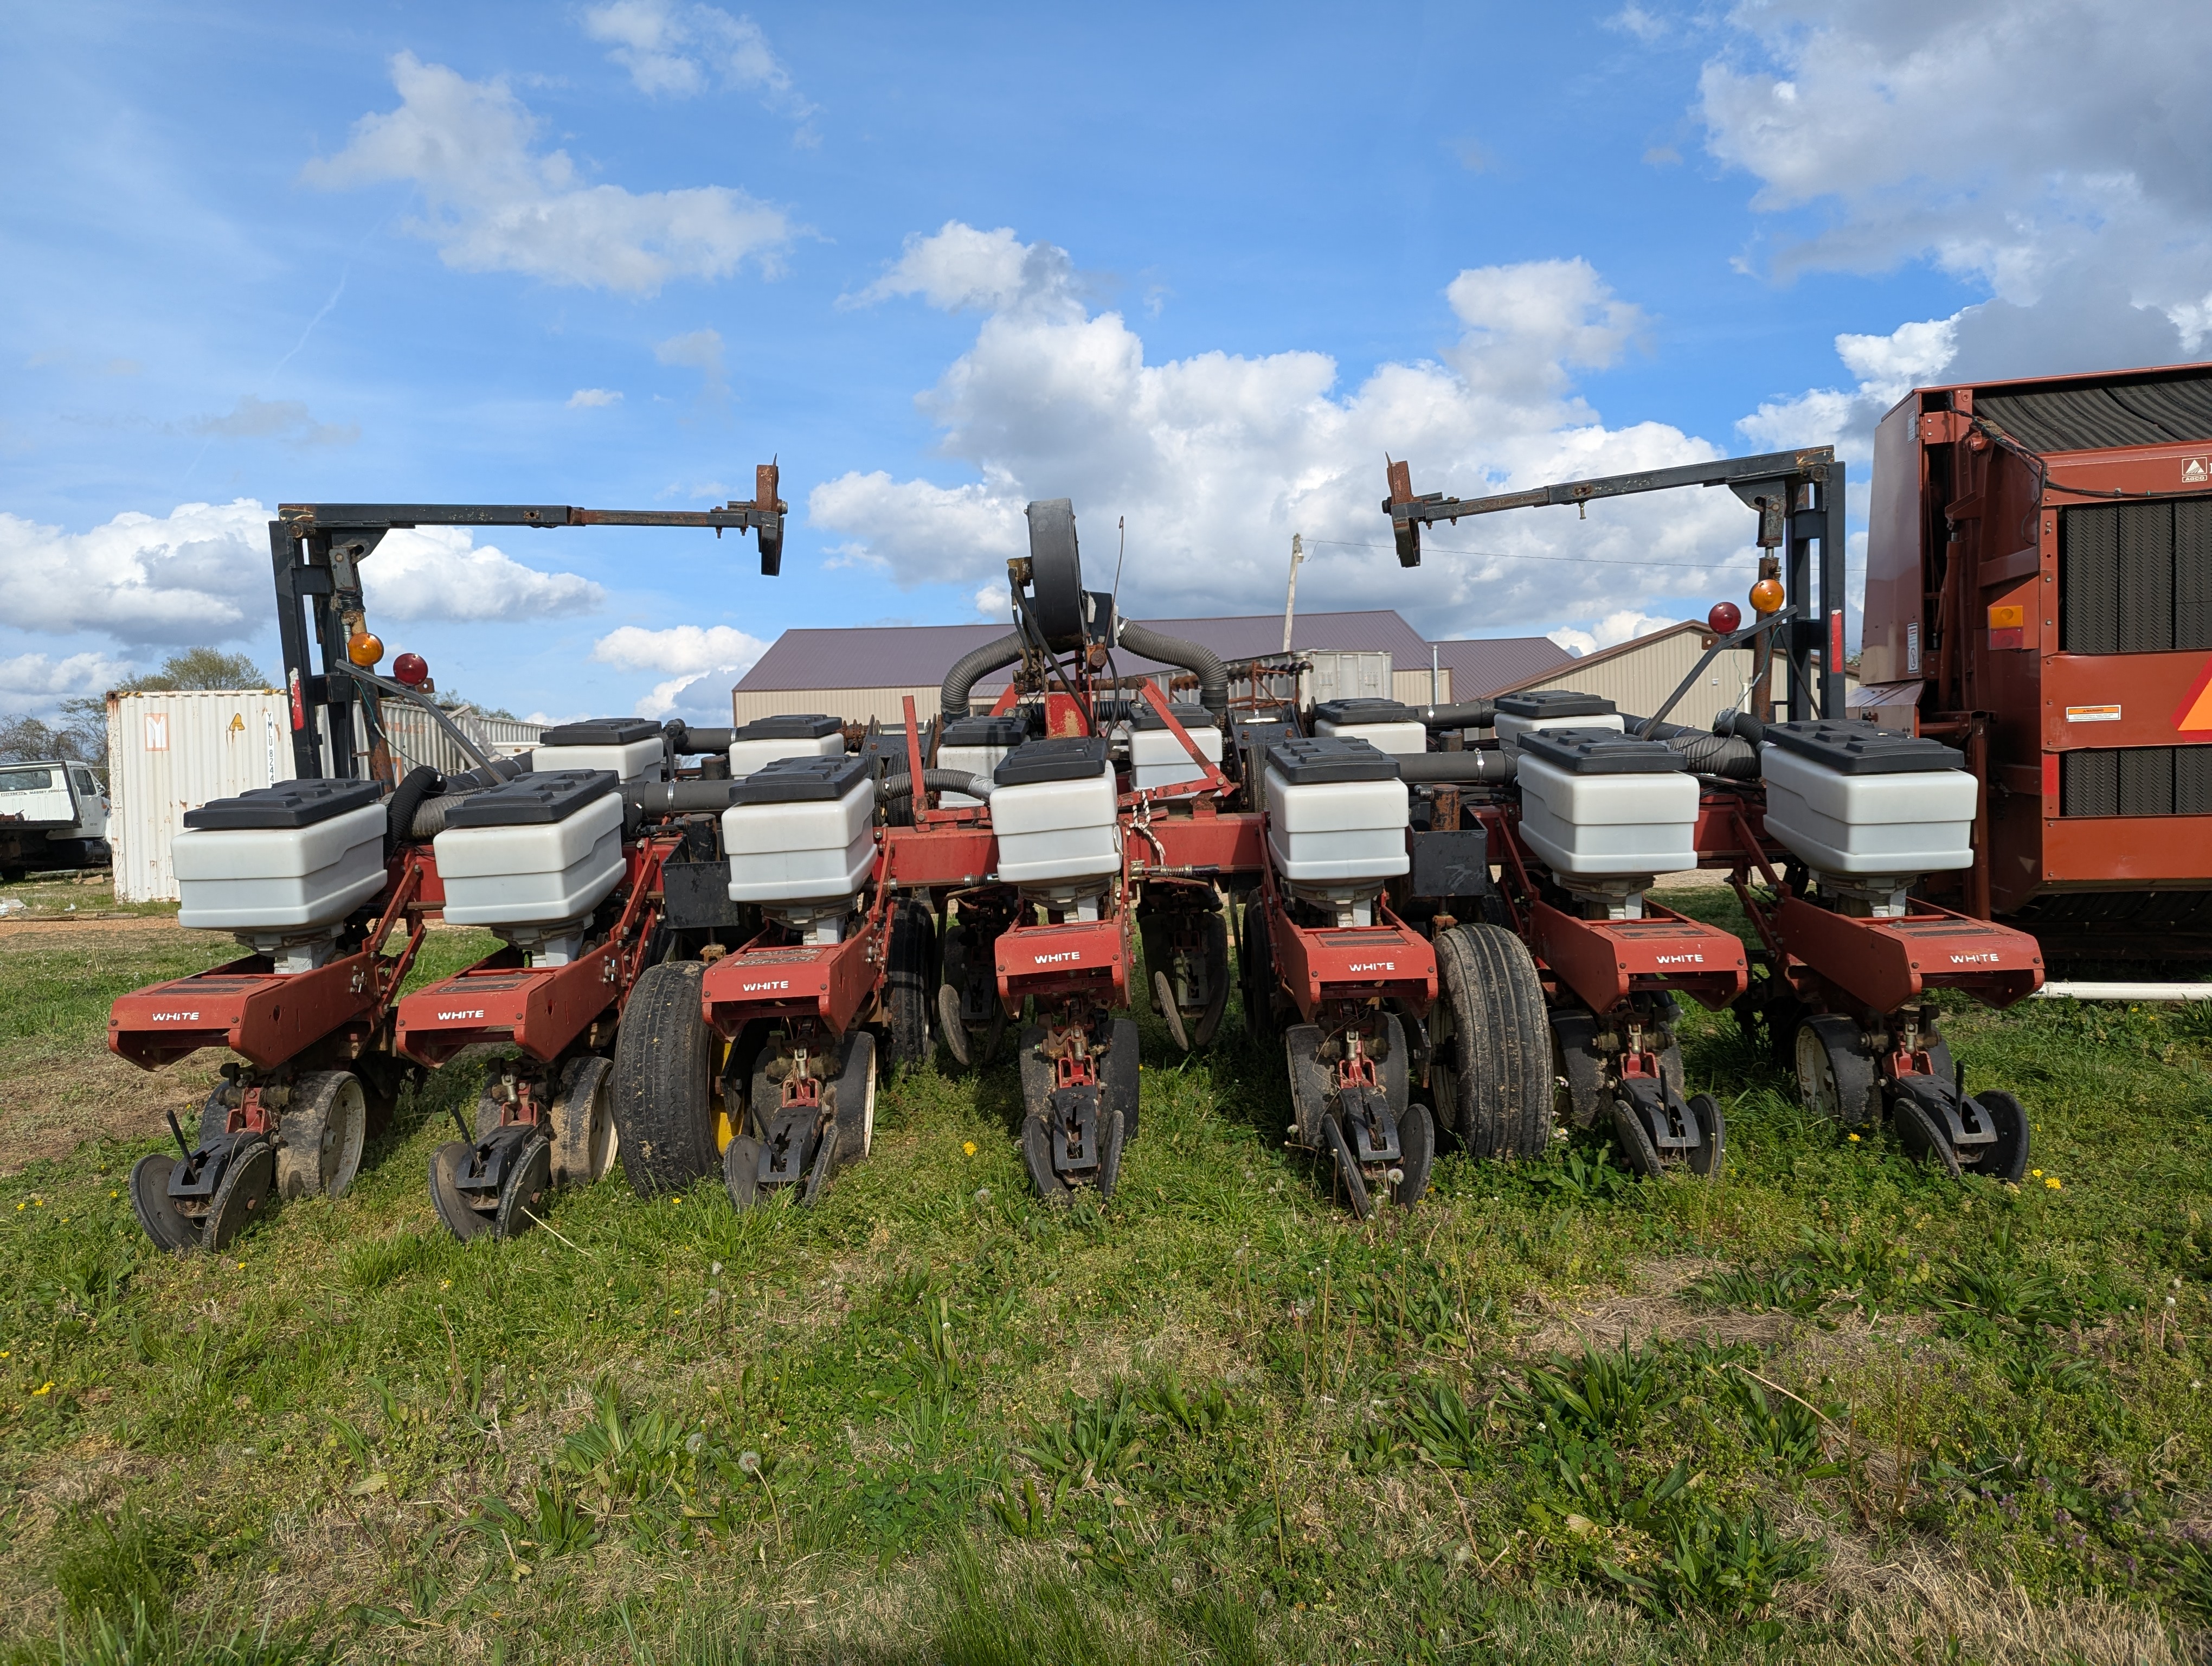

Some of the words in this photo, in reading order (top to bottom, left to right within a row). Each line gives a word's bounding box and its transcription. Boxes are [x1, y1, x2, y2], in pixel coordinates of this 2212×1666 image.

[1035, 952, 1081, 964] WHITE
[1656, 954, 1704, 964] WHITE
[1950, 953, 1999, 963] WHITE
[1349, 962, 1395, 972] WHITE
[743, 981, 789, 991] WHITE
[152, 1012, 200, 1021] WHITE
[438, 1010, 484, 1020] WHITE
